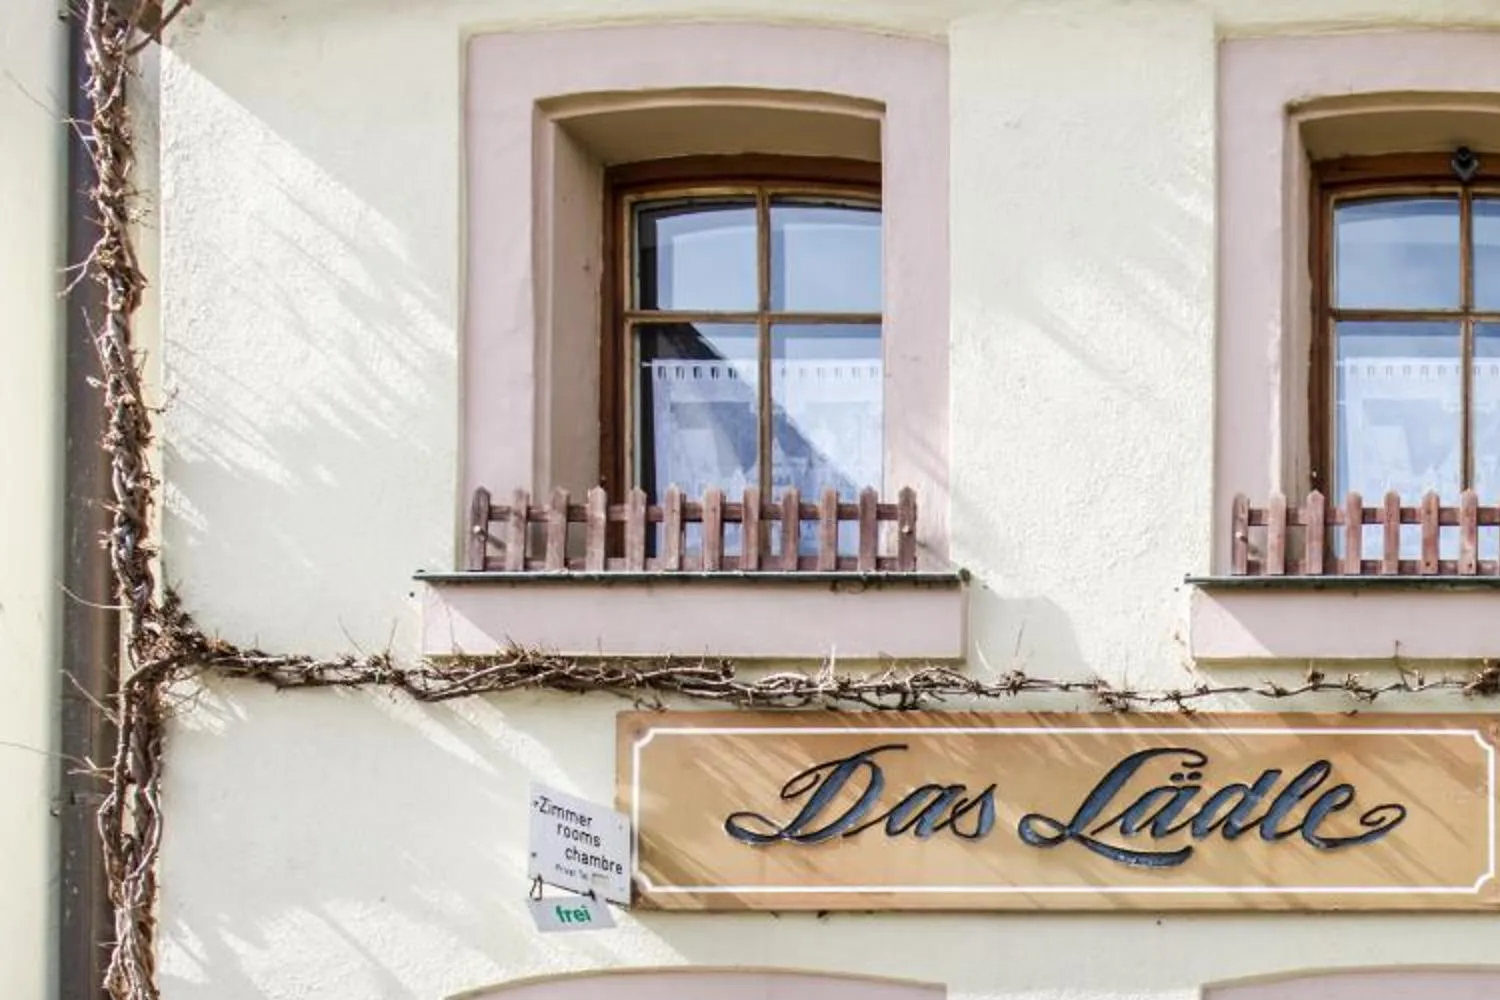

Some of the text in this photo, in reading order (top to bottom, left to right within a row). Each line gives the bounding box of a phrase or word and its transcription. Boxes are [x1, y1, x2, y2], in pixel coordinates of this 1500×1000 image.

[539, 795, 593, 828] Zimmer
[724, 744, 1407, 868] Das Lädle
[556, 823, 601, 848] rooms
[565, 847, 623, 875] chambre
[556, 903, 592, 923] frei
